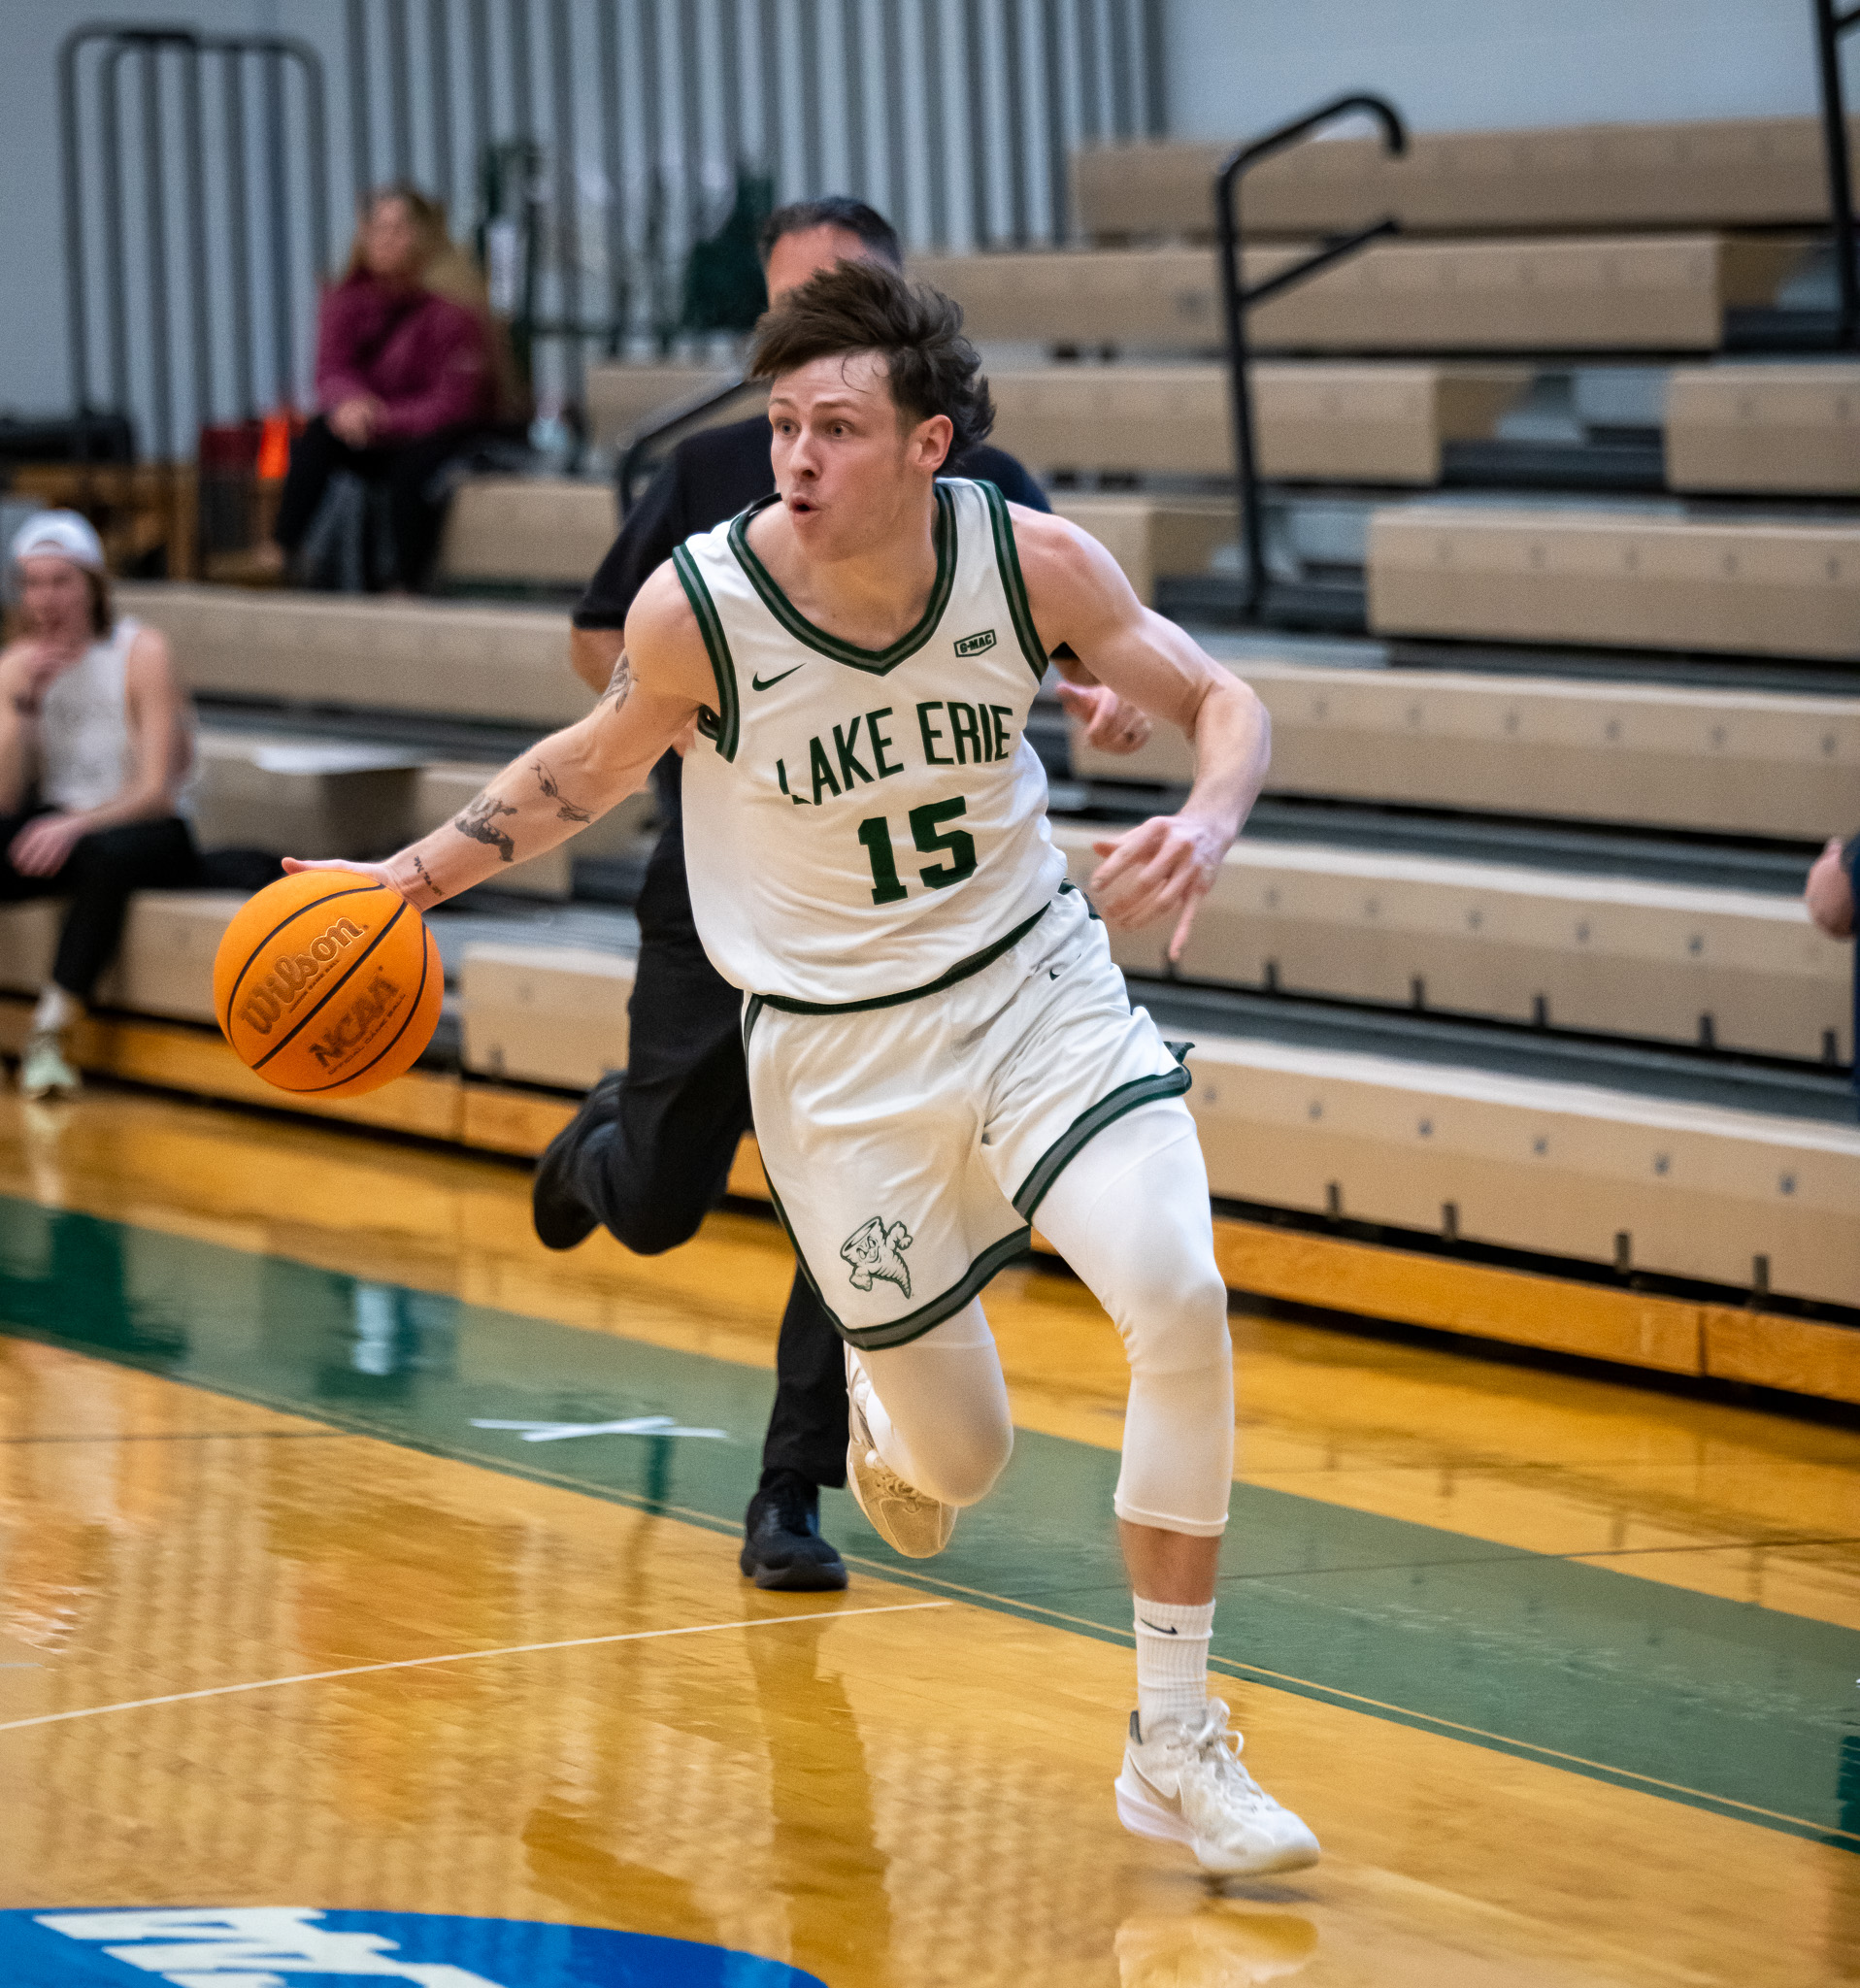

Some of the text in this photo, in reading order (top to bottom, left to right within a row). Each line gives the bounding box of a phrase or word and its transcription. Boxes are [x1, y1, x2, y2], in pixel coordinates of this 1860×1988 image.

[960, 634, 992, 653] G-MAC
[776, 701, 1013, 806] LAKE ERIE
[857, 796, 978, 905] 15
[238, 916, 365, 1036] Wilson
[308, 975, 400, 1069] NCAA
